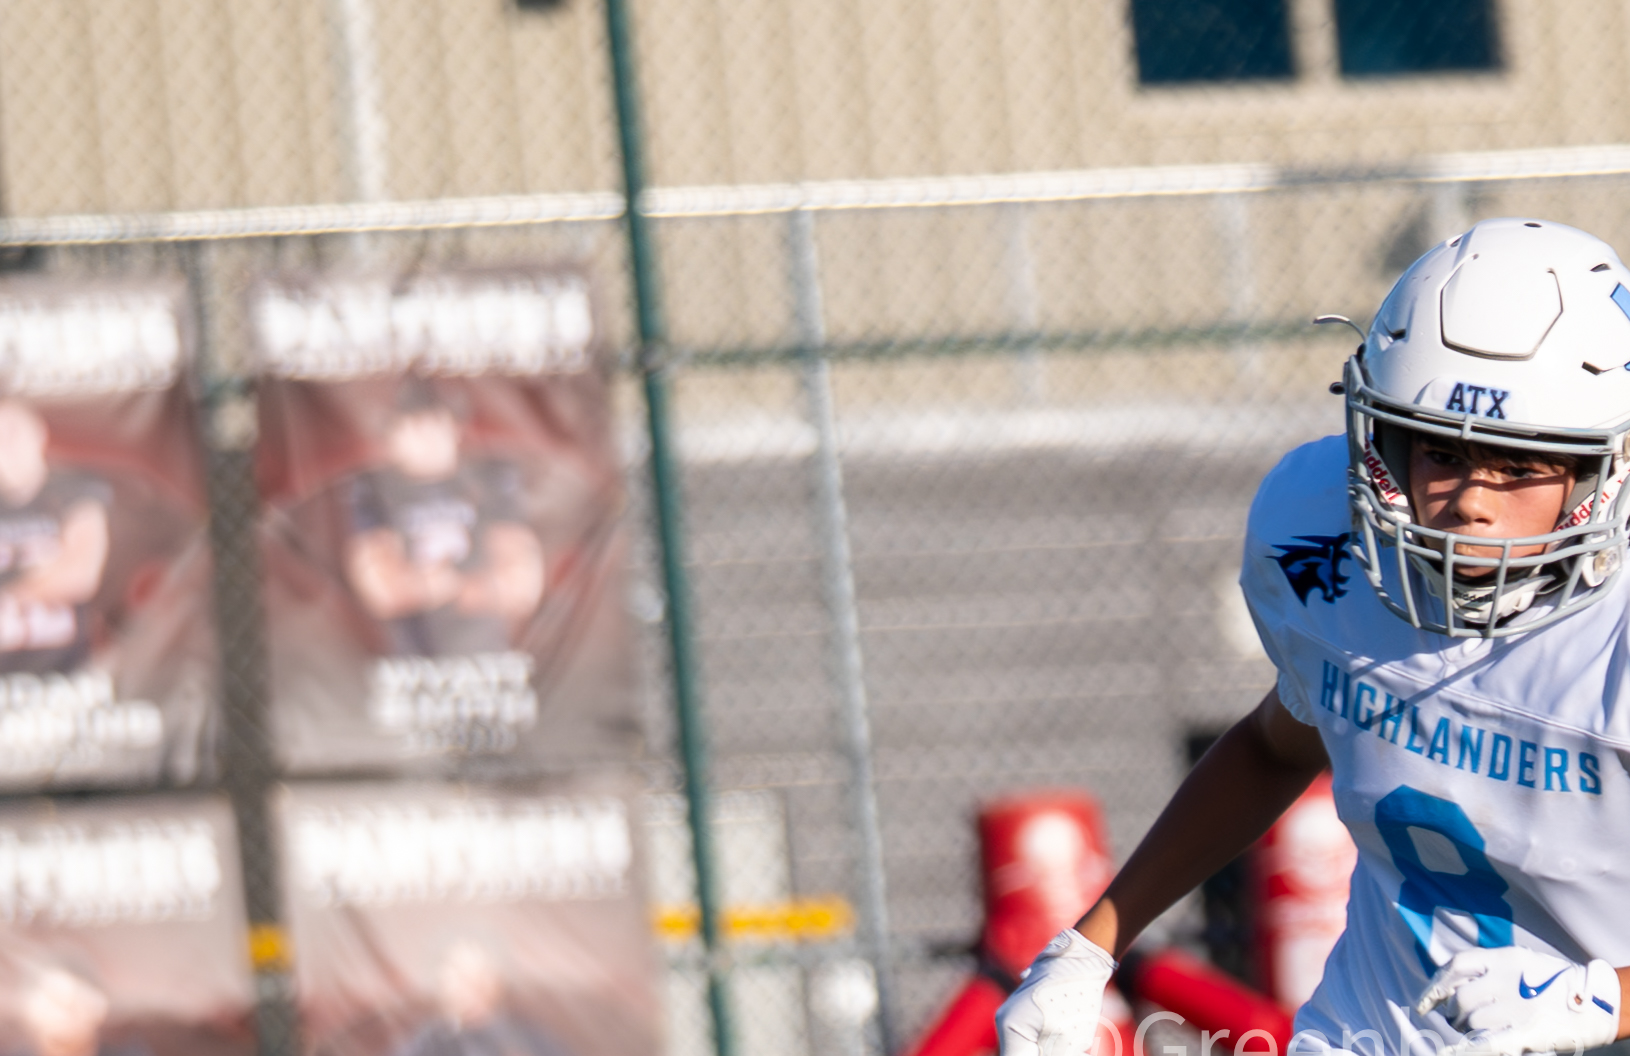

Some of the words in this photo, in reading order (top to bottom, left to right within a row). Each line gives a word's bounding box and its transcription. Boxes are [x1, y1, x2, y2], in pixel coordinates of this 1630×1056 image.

[1445, 381, 1511, 420] ATX
[1320, 658, 1603, 796] HIGHLANDERS
[1374, 783, 1516, 980] 8
